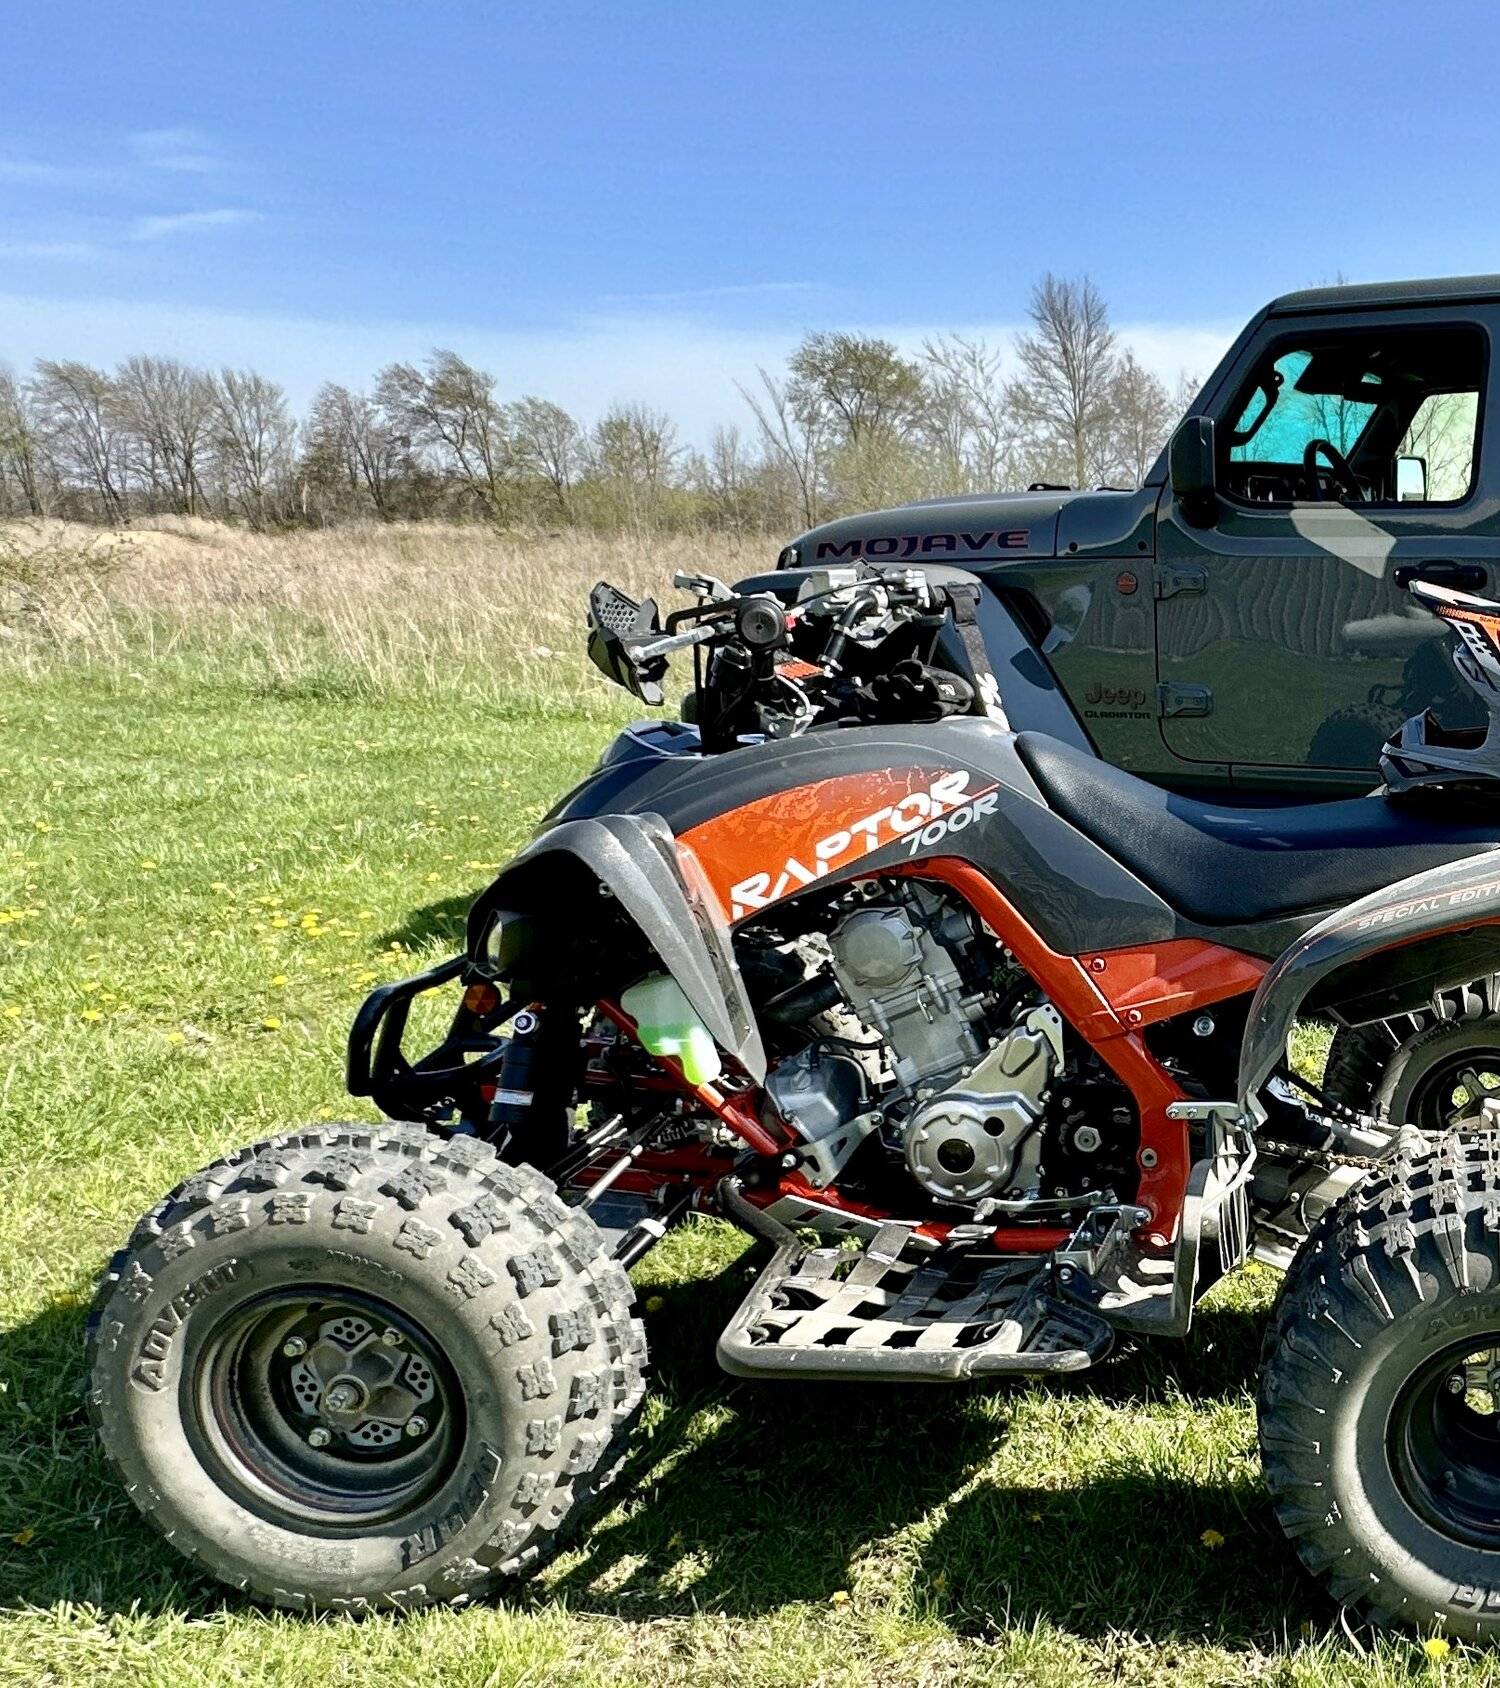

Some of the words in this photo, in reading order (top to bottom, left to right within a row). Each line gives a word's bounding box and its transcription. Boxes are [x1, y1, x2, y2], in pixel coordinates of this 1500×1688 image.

[816, 529, 1029, 559] MOJAVE
[1085, 682, 1146, 710] Jeep
[1084, 711, 1152, 719] GLADIATOR
[901, 792, 999, 856] 700R
[730, 769, 971, 920] RAPTOR
[1357, 897, 1441, 931] SPECIAL
